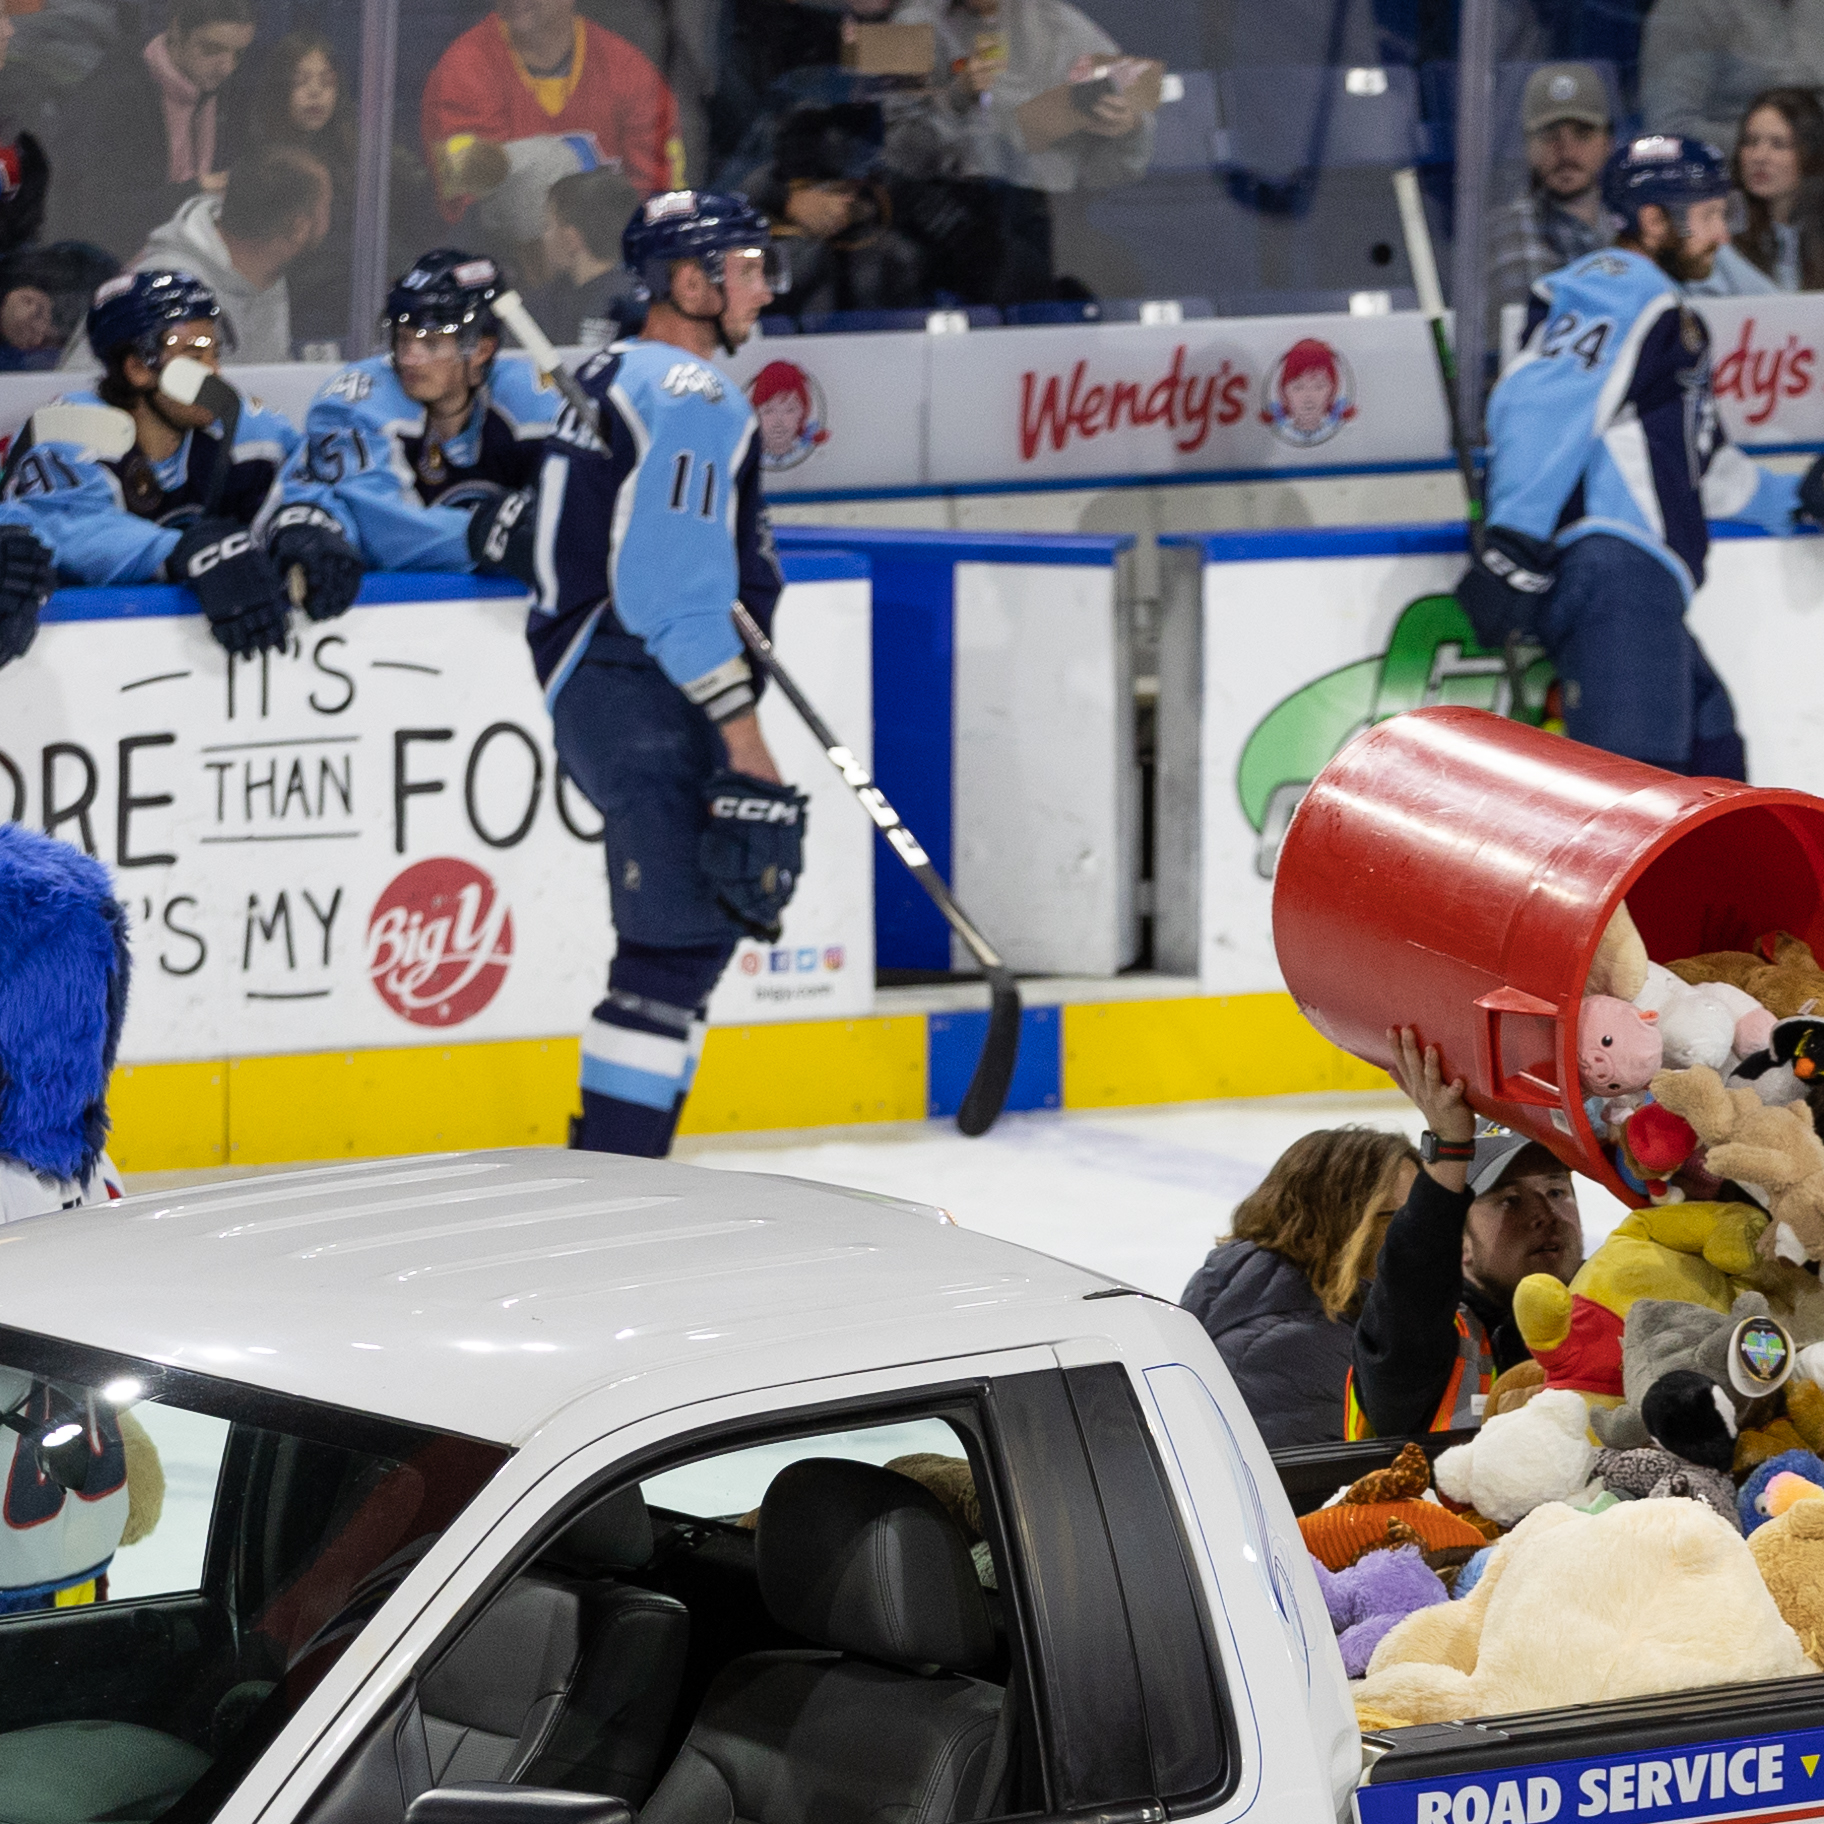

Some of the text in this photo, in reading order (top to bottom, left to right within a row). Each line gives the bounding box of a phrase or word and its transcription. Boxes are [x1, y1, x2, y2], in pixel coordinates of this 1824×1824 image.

[1020, 345, 1249, 461] Wendy's
[667, 448, 718, 524] 11
[224, 633, 358, 721] IT'S
[205, 755, 356, 824] THAN
[242, 885, 344, 973] MY
[1577, 1742, 1786, 1820] SERVICE
